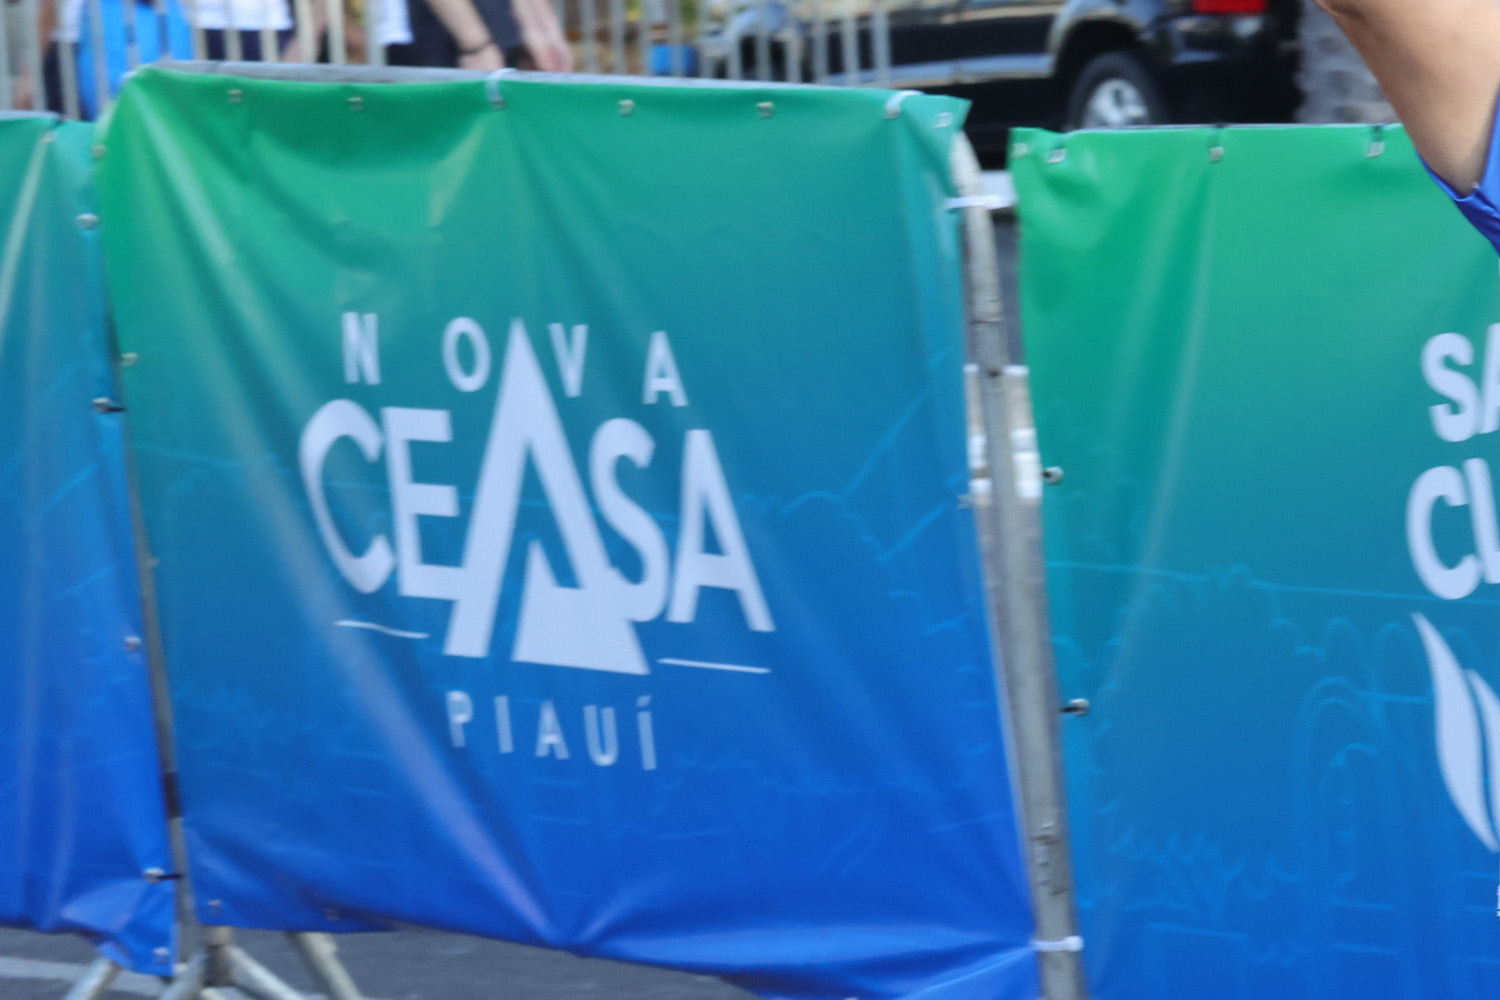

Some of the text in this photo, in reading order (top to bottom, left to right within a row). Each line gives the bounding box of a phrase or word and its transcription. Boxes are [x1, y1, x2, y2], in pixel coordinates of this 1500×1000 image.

[341, 310, 689, 408] NOVA
[298, 316, 777, 676] CEASA
[445, 690, 658, 772] PIAUÍ
